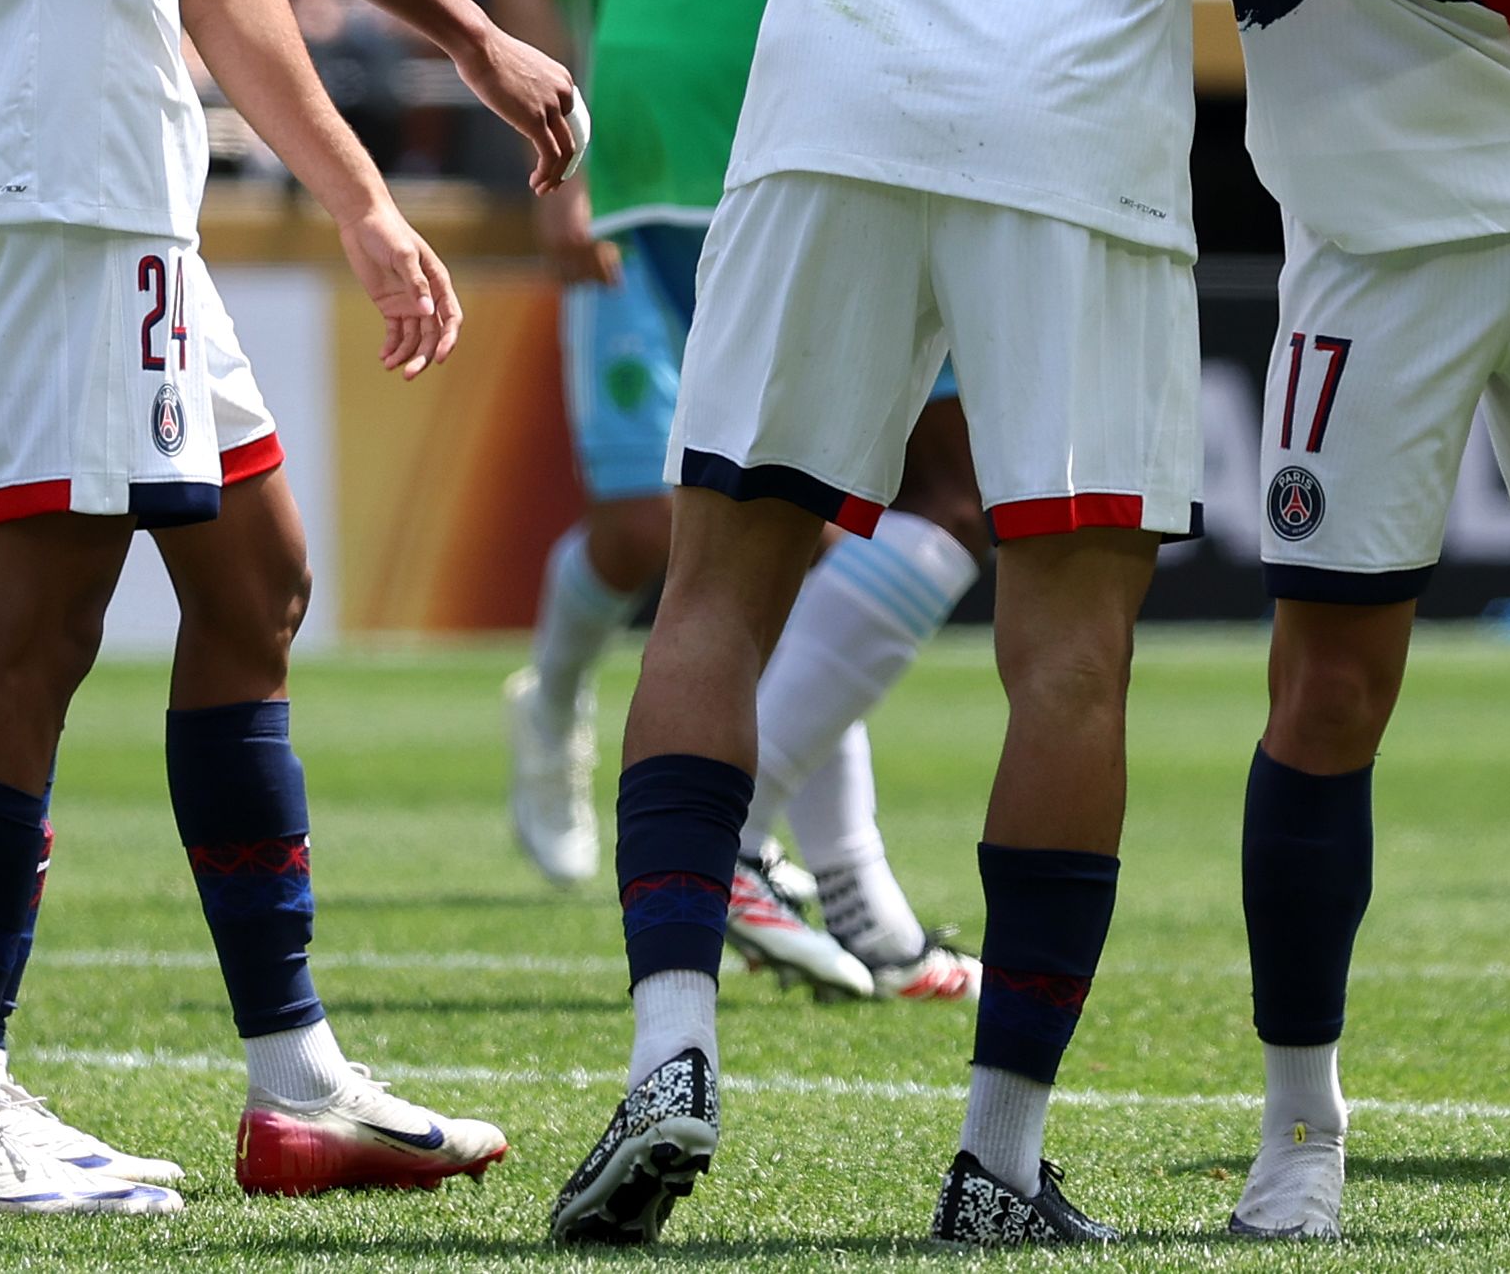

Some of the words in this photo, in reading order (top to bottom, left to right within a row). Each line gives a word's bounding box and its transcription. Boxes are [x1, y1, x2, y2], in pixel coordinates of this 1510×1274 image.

[137, 254, 188, 371] 24
[1280, 332, 1352, 453] 17
[1278, 471, 1313, 490] PARIS
